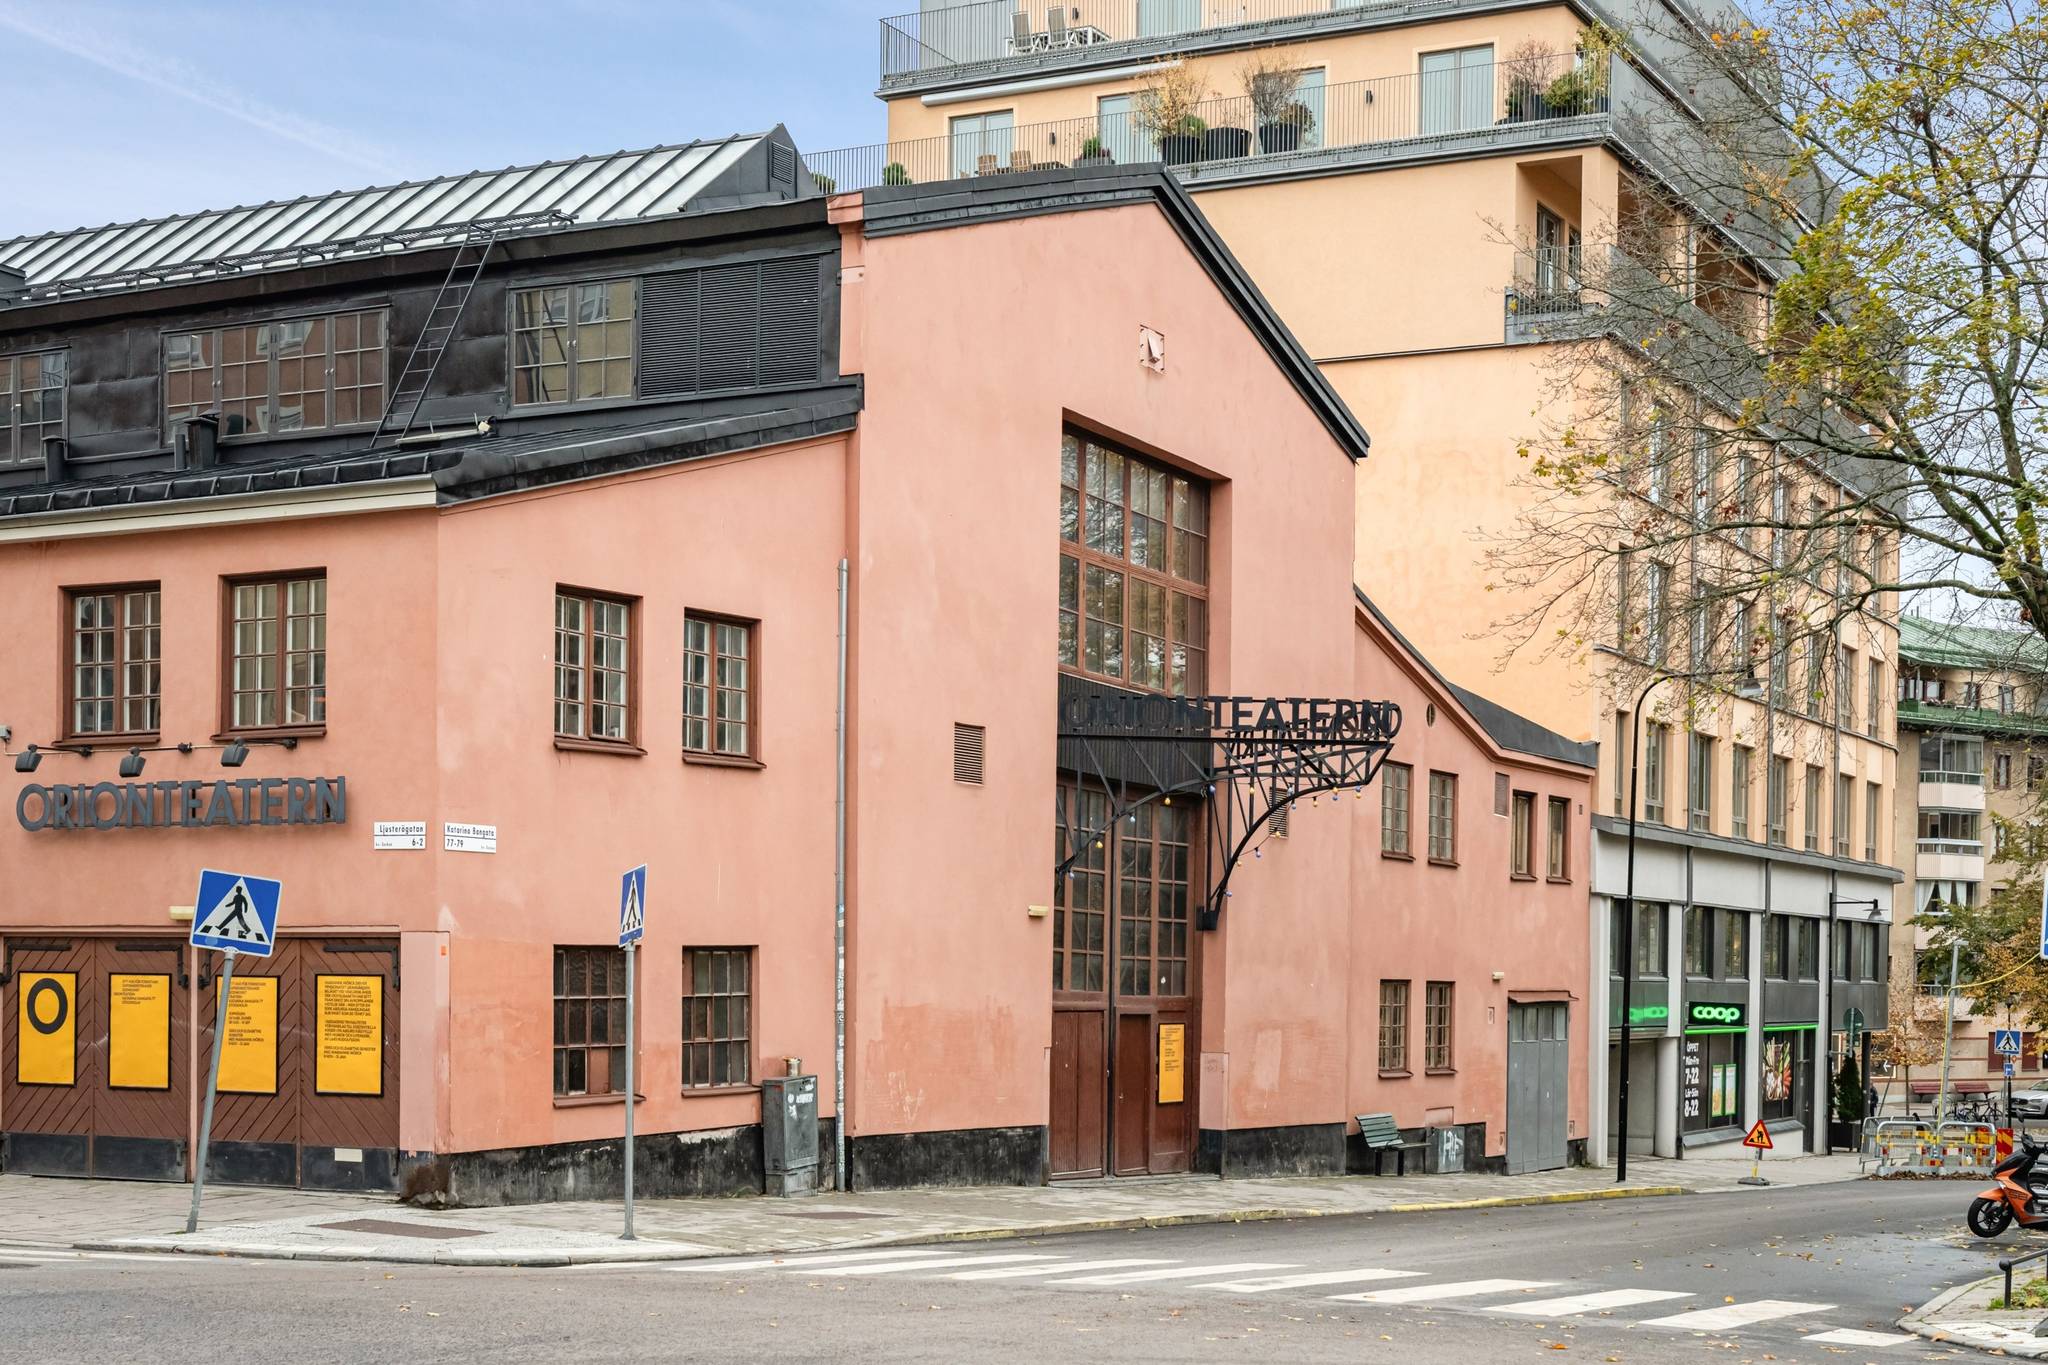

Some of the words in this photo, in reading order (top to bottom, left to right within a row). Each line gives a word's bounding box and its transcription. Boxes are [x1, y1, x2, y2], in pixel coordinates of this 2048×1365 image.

[1061, 694, 1391, 737] ORIONTEATERN
[16, 776, 346, 832] ORIONTEATERN
[446, 825, 471, 835] Katarina
[472, 827, 495, 839] Bangata
[411, 838, 424, 847] 6-2
[446, 838, 464, 848] 77-79
[1693, 1006, 1741, 1023] coop
[1685, 1067, 1699, 1085] 7-22
[1684, 1099, 1699, 1117] 8-22
